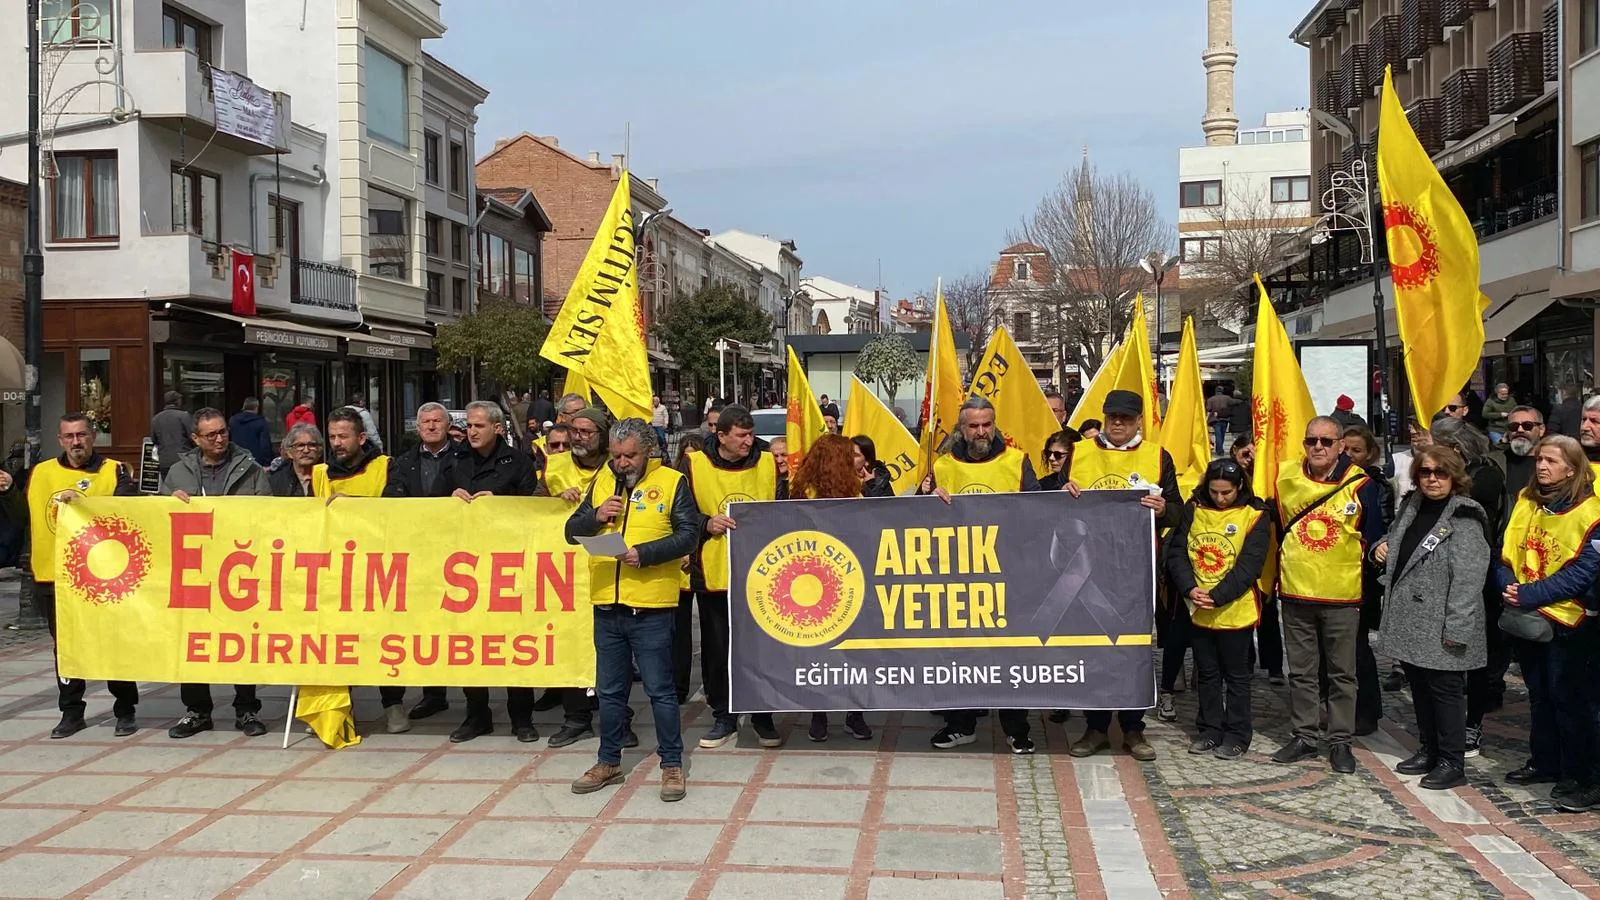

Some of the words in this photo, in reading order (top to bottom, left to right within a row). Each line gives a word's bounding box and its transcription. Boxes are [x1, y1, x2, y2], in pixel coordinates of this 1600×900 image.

[559, 309, 605, 366] SEN
[169, 508, 408, 613] EĞİTİM
[441, 551, 577, 613] SEN
[756, 538, 817, 577] EĞİTİM
[823, 544, 857, 575] SEN
[873, 525, 1001, 576] ARTIK
[873, 582, 1008, 630] YETER!
[187, 622, 360, 665] EDİRNE
[379, 622, 555, 678] ŞUBESİ
[795, 662, 868, 686] EĞİTİM
[875, 666, 915, 685] SEN
[923, 661, 1002, 685] EDİRNE
[1009, 660, 1085, 689] ŞUBESİ
